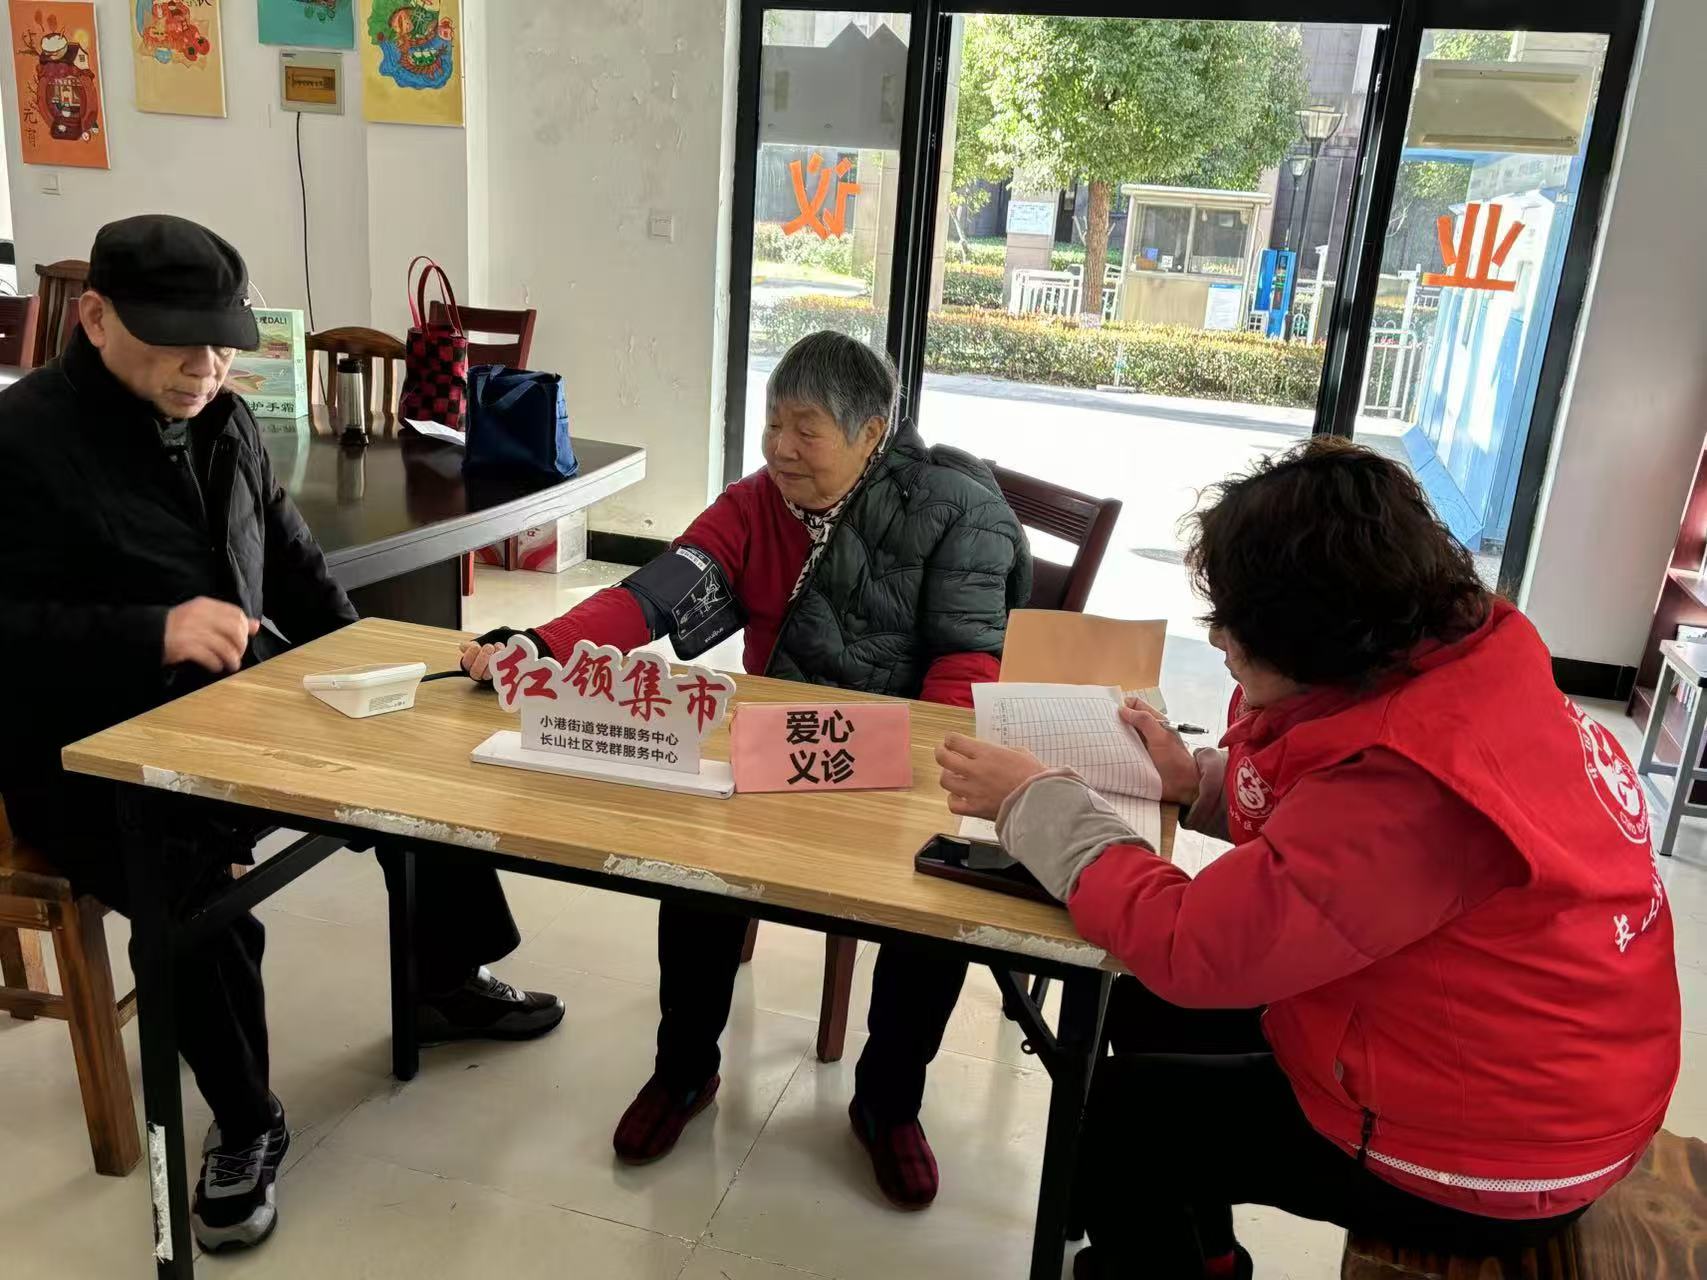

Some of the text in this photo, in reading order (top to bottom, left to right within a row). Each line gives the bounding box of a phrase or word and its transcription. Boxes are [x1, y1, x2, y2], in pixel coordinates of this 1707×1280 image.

[497, 644, 727, 734] 红领集市
[540, 715, 679, 746] 小港街道党群服务中心
[786, 709, 855, 745] 爱心
[540, 732, 679, 764] 长山社区党群服务中心
[786, 748, 855, 785] 义诊
